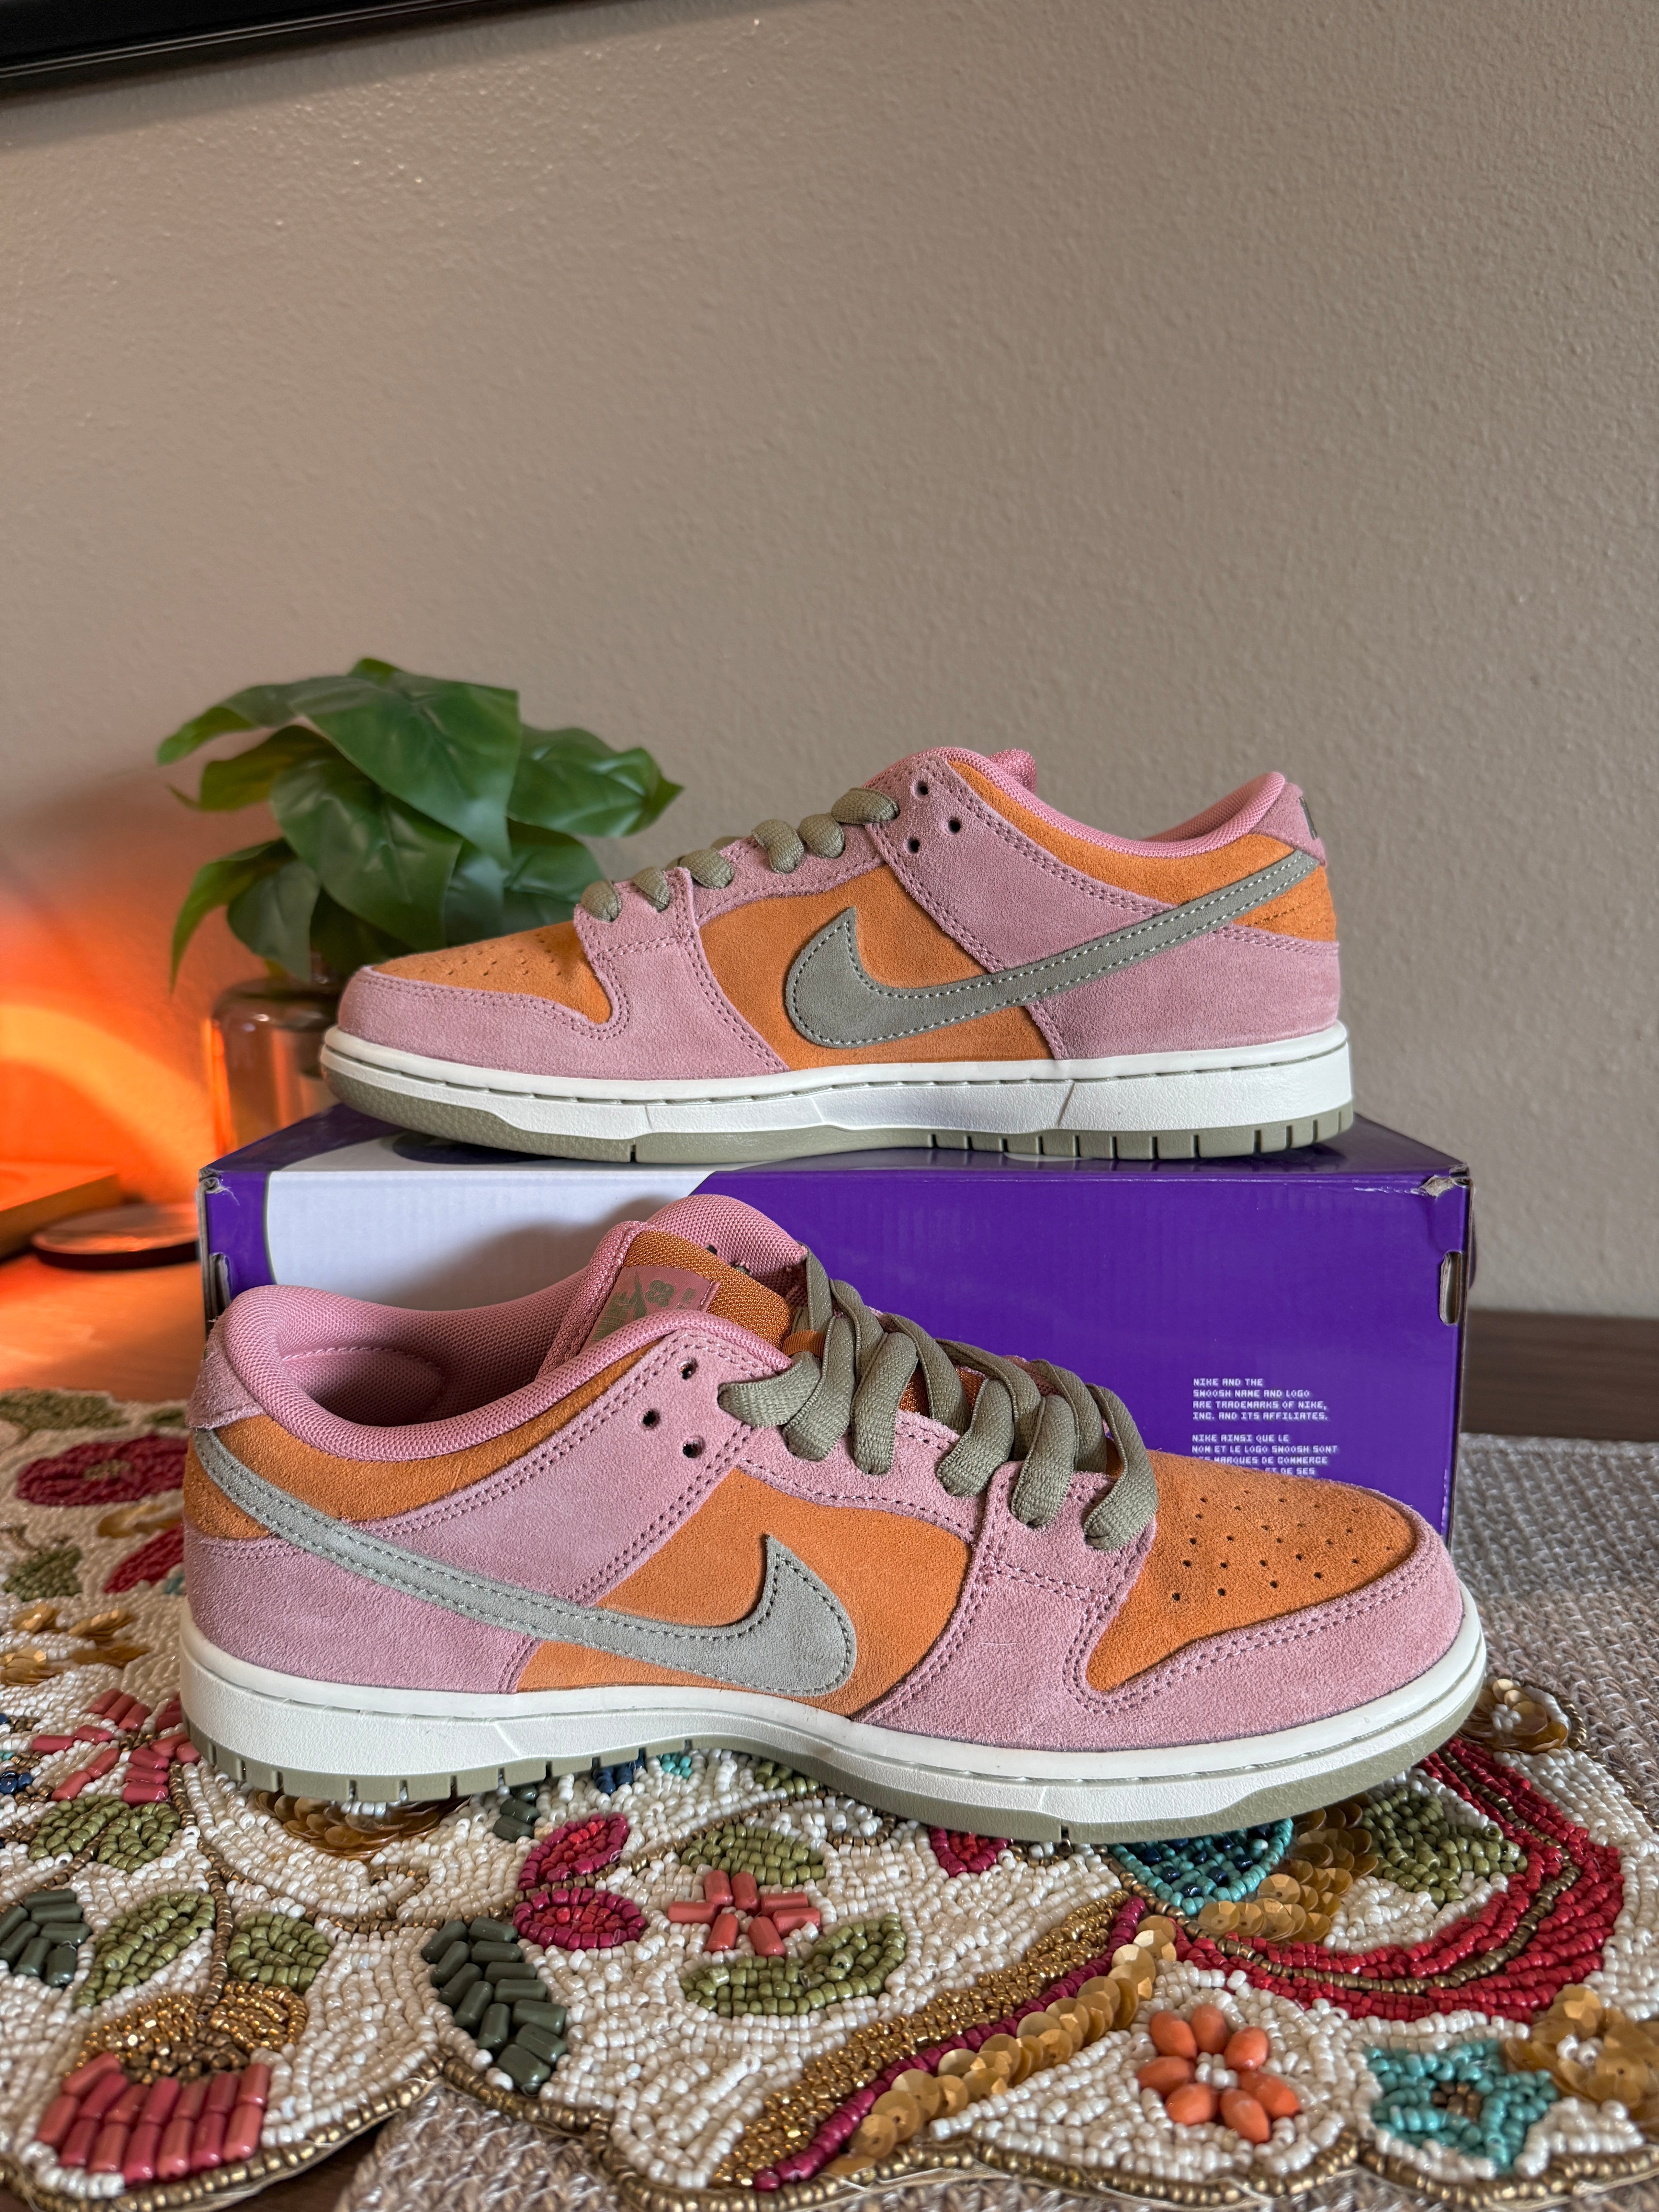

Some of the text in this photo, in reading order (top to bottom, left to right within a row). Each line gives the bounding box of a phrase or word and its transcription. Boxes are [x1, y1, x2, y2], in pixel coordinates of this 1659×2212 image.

[1193, 1378, 1263, 1386] NIKE AND THE
[1193, 1389, 1309, 1398] SWOOSH NAME AND LOGO
[1193, 1401, 1327, 1410] ARE TRADEMARKS OF NIKE,
[1193, 1412, 1328, 1420] INC. AND ITS AFFILIATES.
[1256, 1434, 1275, 1444] QUE
[1214, 1456, 1258, 1466] MARQUES
[1278, 1456, 1328, 1465] COMMERCE
